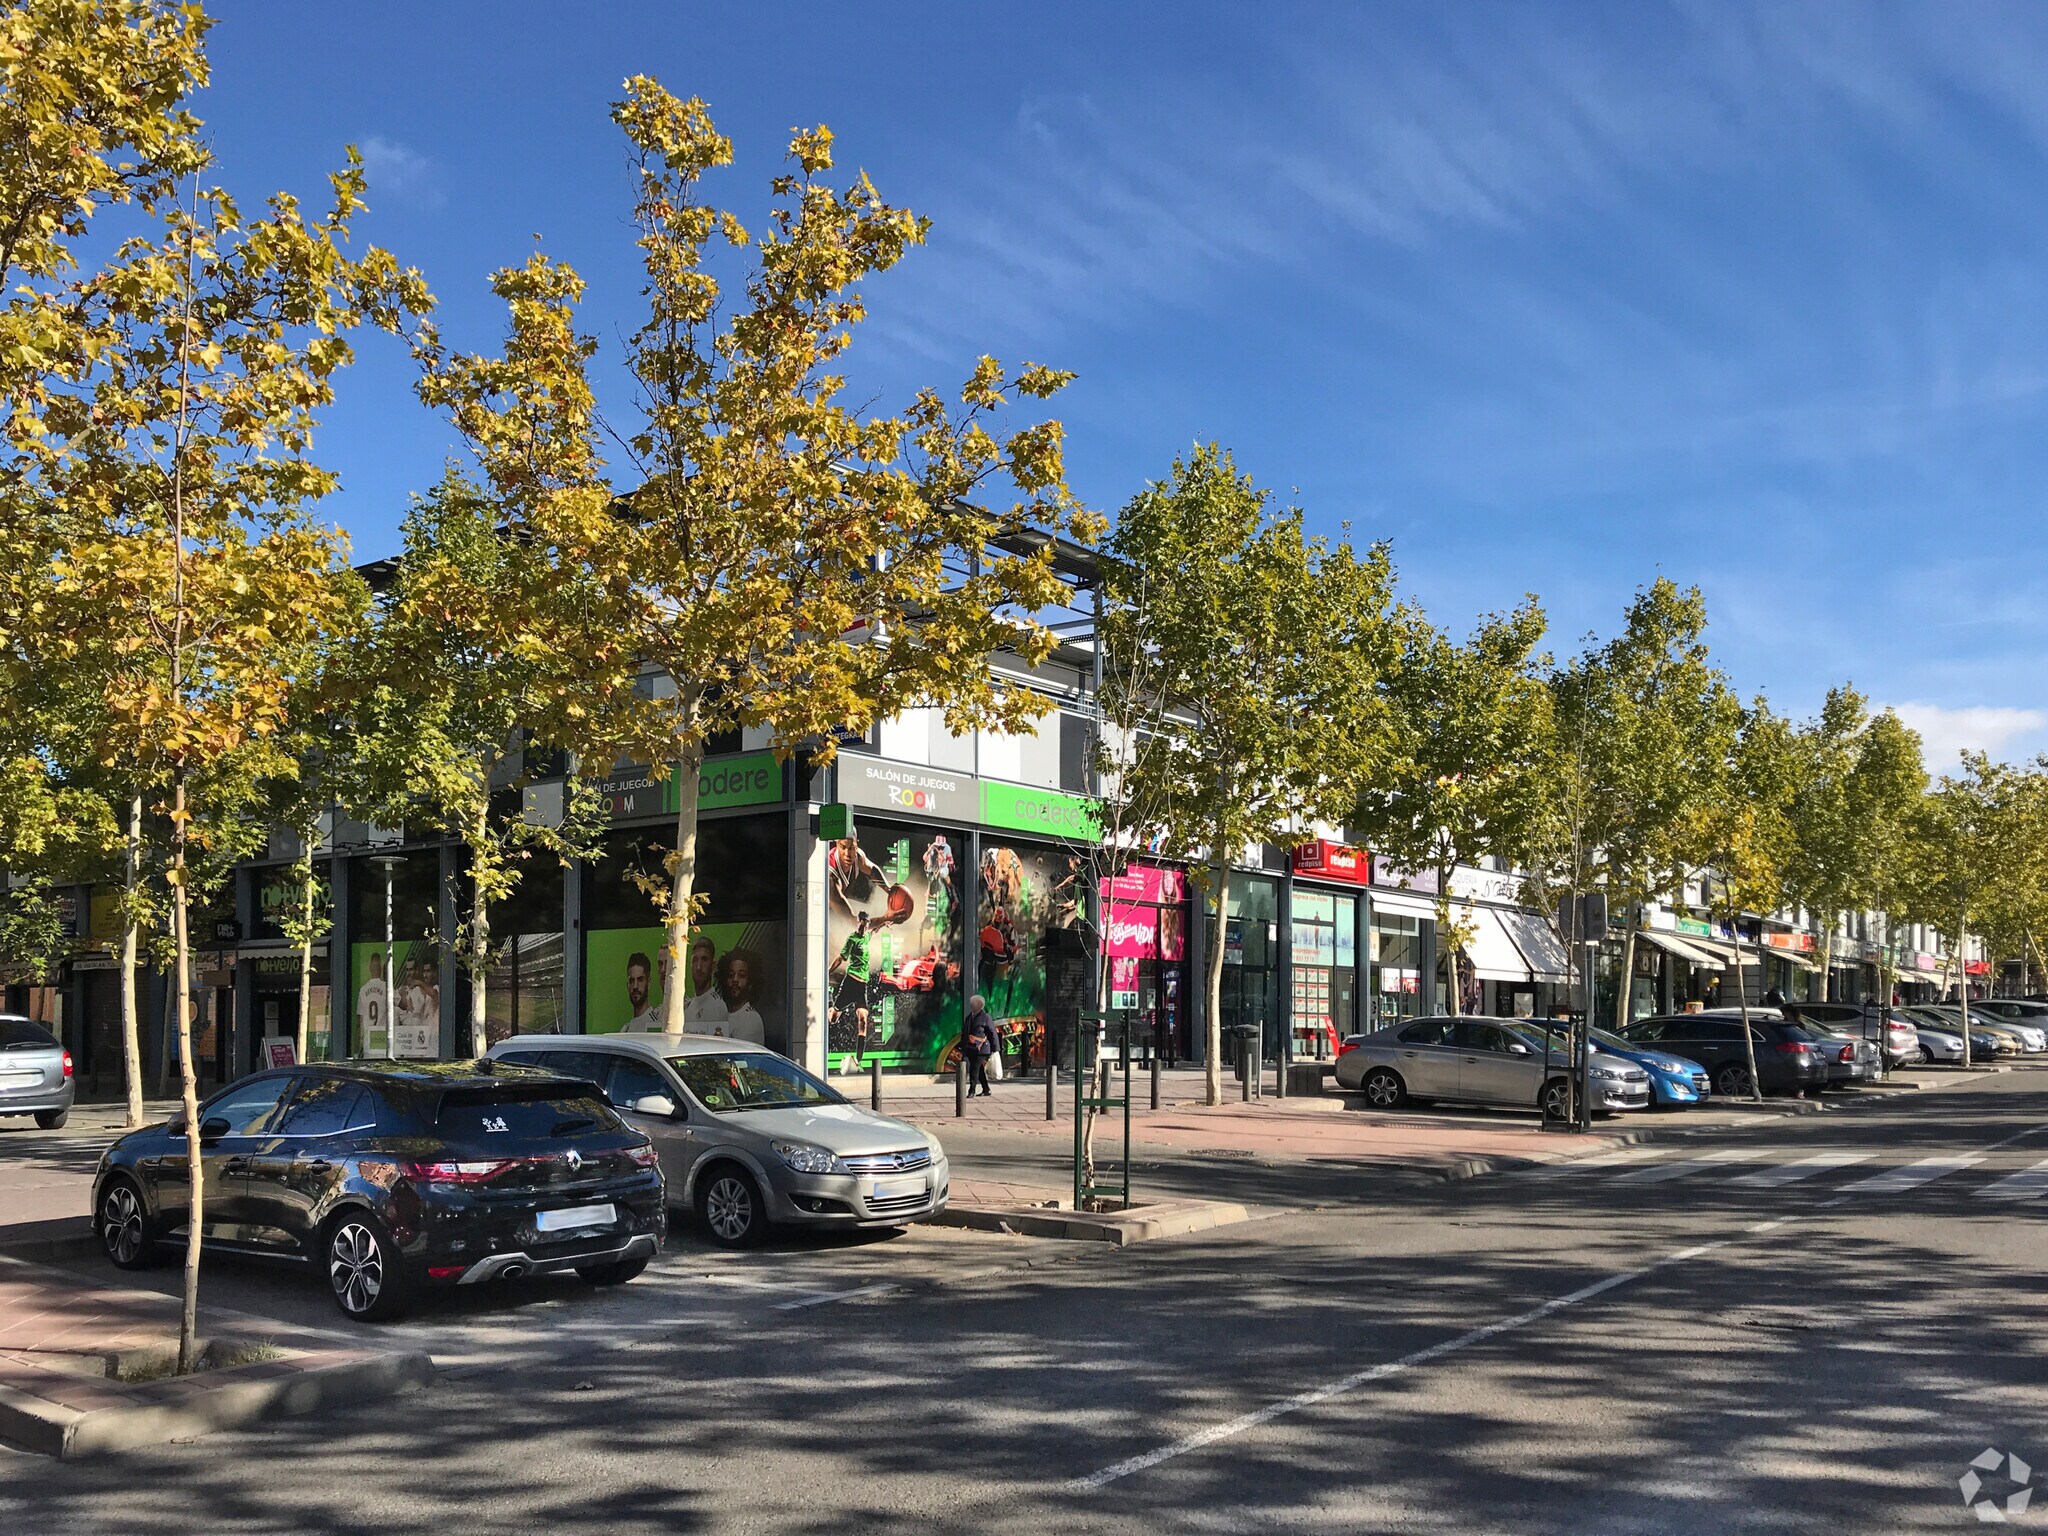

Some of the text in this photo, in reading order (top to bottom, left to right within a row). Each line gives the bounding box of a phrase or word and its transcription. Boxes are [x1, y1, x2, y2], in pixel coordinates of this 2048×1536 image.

[603, 783, 616, 792] DE
[699, 767, 770, 798] odere
[866, 767, 956, 792] SALÓN DE JUEGOS
[888, 784, 936, 813] ROOM
[1014, 799, 1080, 828] codere
[1298, 860, 1323, 868] redpiso
[1330, 854, 1356, 869] redpiso
[368, 1000, 379, 1026] 9
